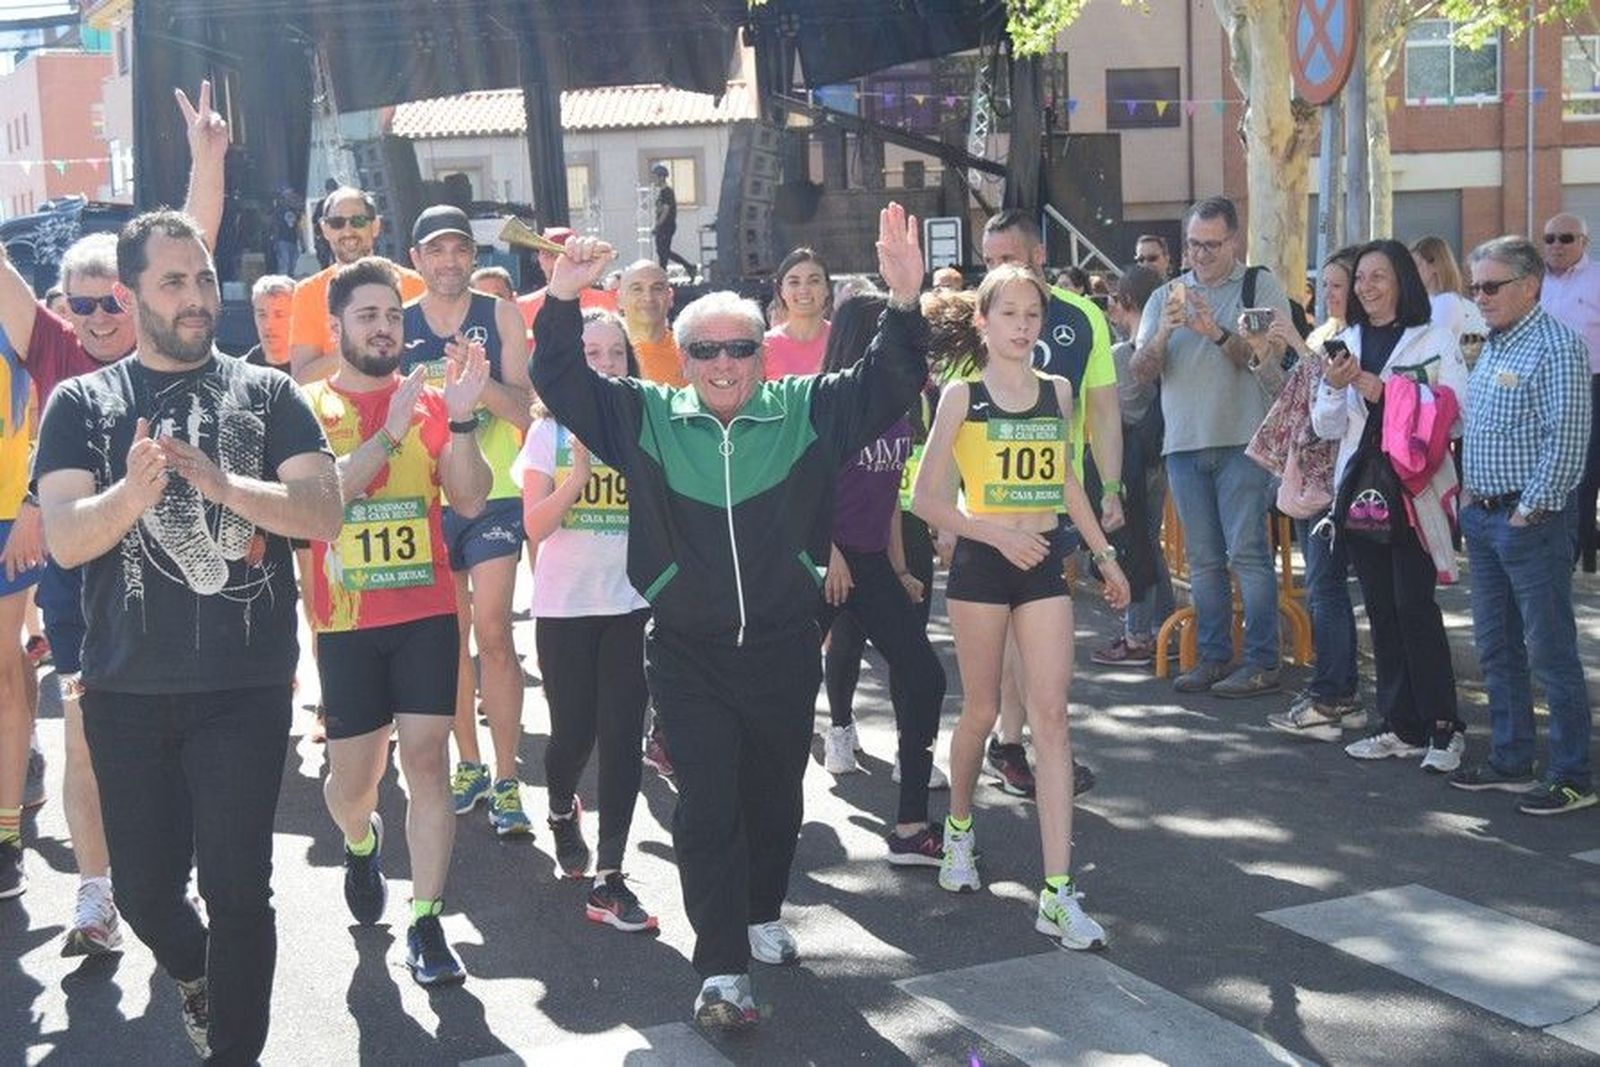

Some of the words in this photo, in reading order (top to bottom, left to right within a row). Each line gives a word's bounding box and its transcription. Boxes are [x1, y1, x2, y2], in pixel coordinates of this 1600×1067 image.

[995, 446, 1056, 481] 103
[574, 472, 628, 505] 019
[1009, 490, 1034, 500] CAJA
[354, 525, 417, 564] 113
[370, 571, 396, 583] CAJA
[397, 569, 429, 581] RURAL
